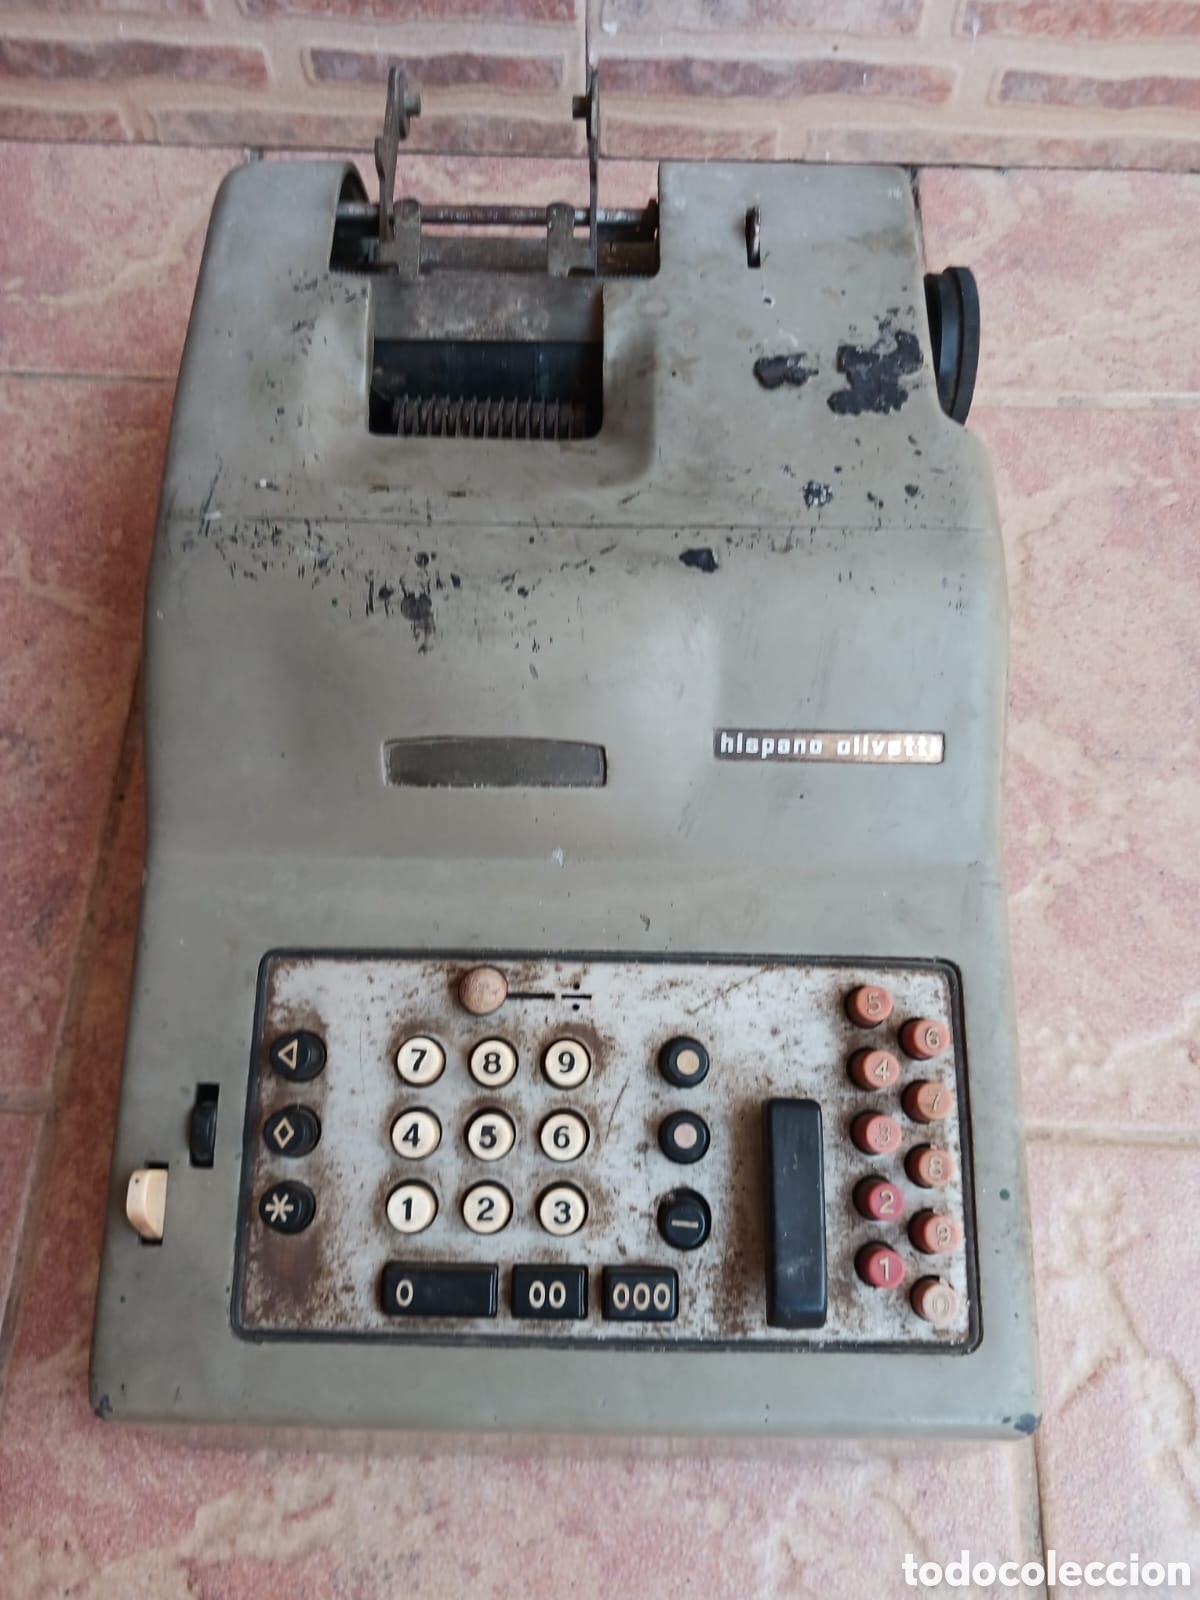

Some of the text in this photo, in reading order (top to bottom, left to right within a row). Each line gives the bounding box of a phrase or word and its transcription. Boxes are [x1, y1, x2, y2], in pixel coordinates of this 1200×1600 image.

[867, 992, 881, 1015] 5
[410, 1049, 427, 1072] 7
[482, 1052, 502, 1074] 8
[558, 1051, 576, 1073] 9
[875, 1058, 890, 1080] 4
[402, 1123, 420, 1147] 4
[479, 1125, 497, 1149] 5
[553, 1126, 571, 1149] 6
[402, 1197, 413, 1221] 1
[476, 1197, 495, 1222] 2
[553, 1200, 572, 1224] 3
[879, 1190, 894, 1214] 2
[879, 1257, 890, 1281] 1
[396, 1278, 414, 1307] 0
[528, 1279, 567, 1309] 00
[612, 1281, 671, 1312] 000
